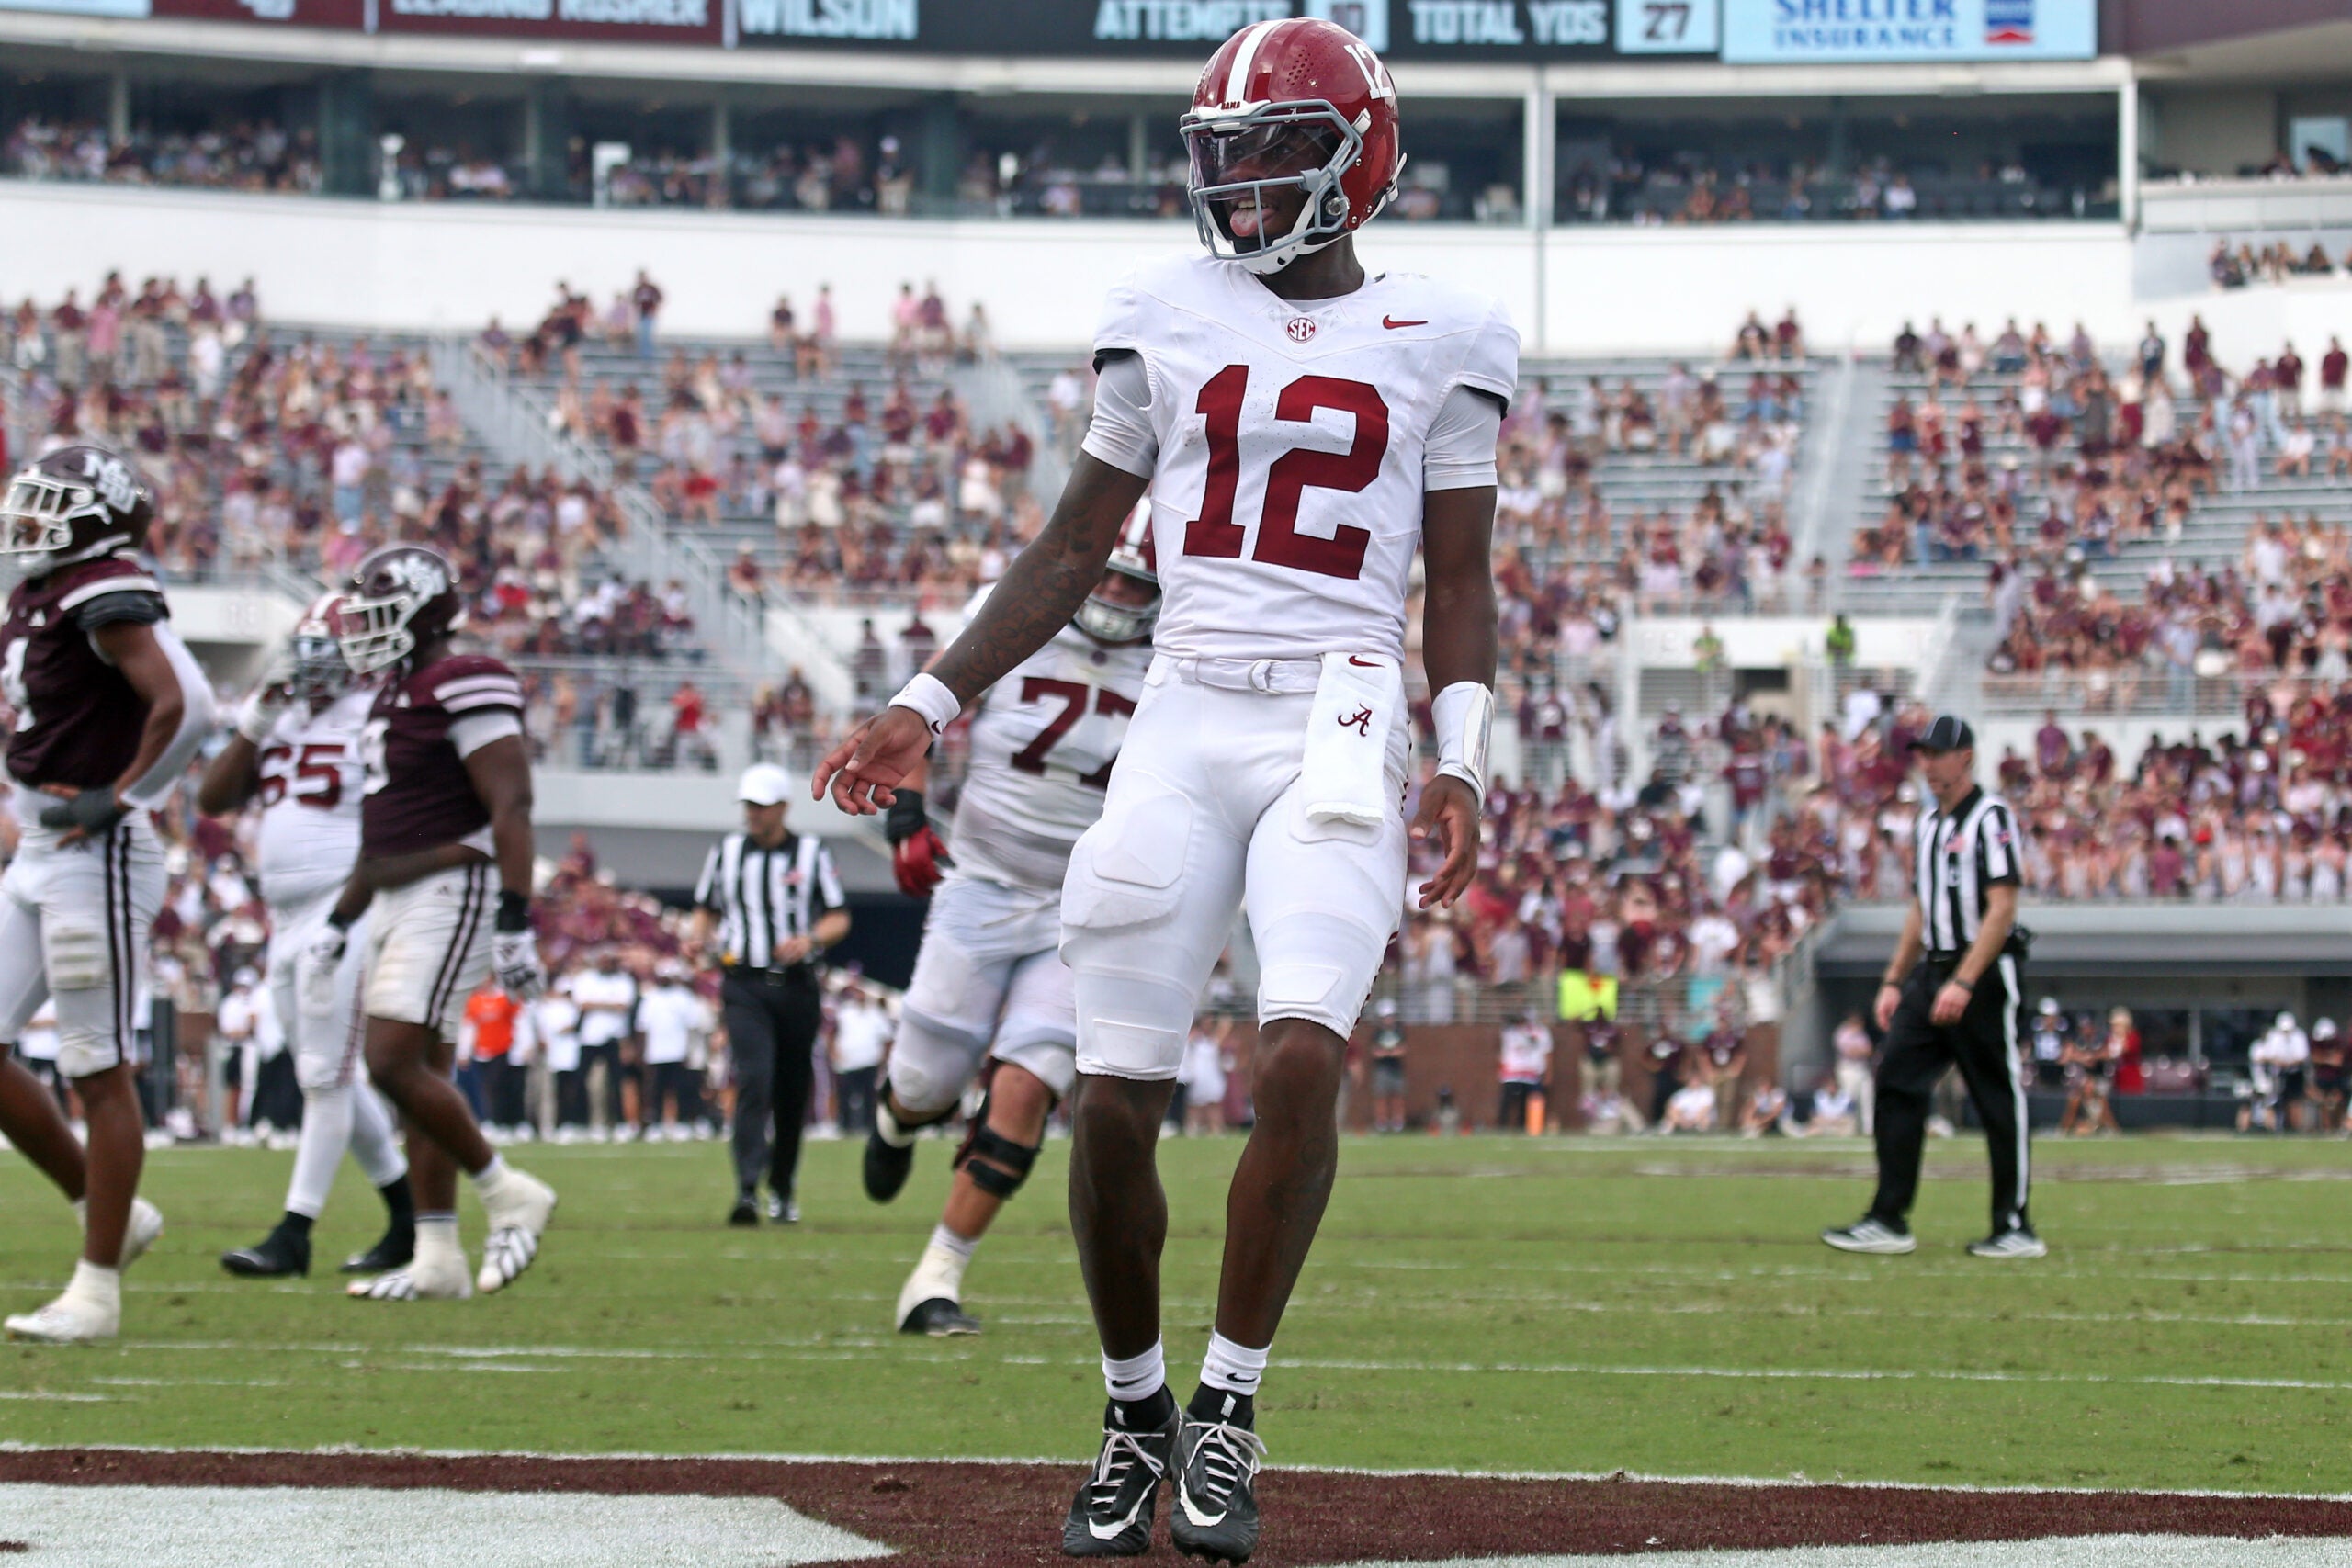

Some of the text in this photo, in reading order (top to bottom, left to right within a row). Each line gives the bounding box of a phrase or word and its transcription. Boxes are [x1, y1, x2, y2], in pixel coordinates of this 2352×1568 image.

[740, 0, 918, 39] WILSON
[1408, 1, 1609, 44] TOTAL YDS
[1642, 4, 1690, 41] 27
[1774, 27, 1955, 47] INSURANCE
[1344, 43, 1392, 100] 12
[1288, 318, 1316, 341] SEC
[1183, 365, 1389, 579] 12
[1012, 677, 1138, 793] 77
[260, 744, 346, 811] 65
